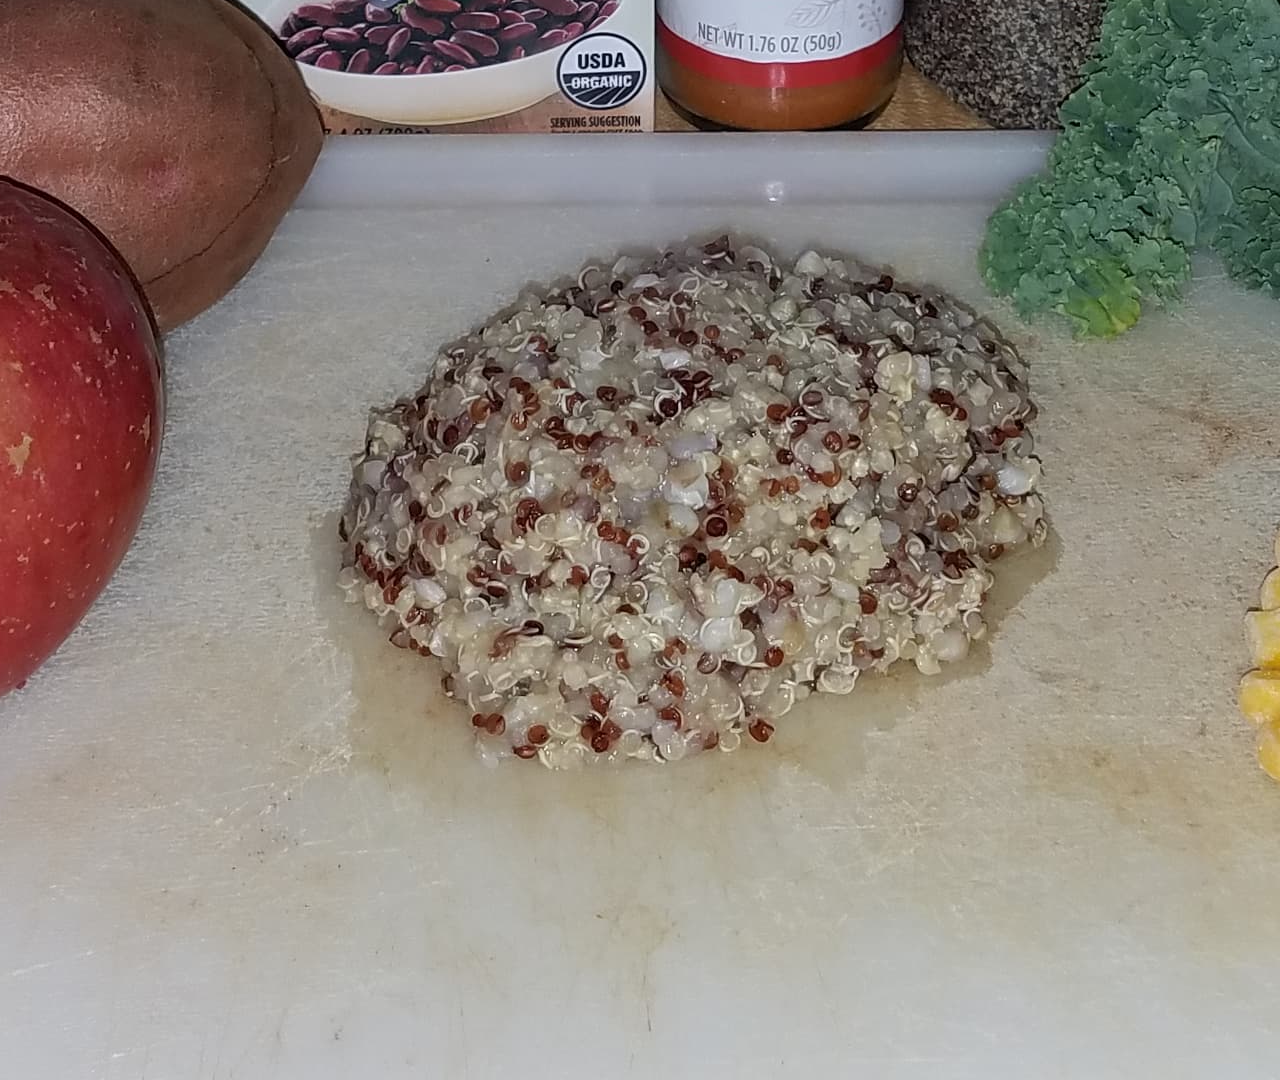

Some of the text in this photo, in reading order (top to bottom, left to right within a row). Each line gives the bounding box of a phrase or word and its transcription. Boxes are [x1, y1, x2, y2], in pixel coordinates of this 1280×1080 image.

[698, 22, 842, 54] NET WT 1.76 OZ (50g)
[576, 52, 626, 70] USDA
[571, 75, 632, 90] ORGANIC
[550, 116, 641, 128] SERVING SUGGESTION
